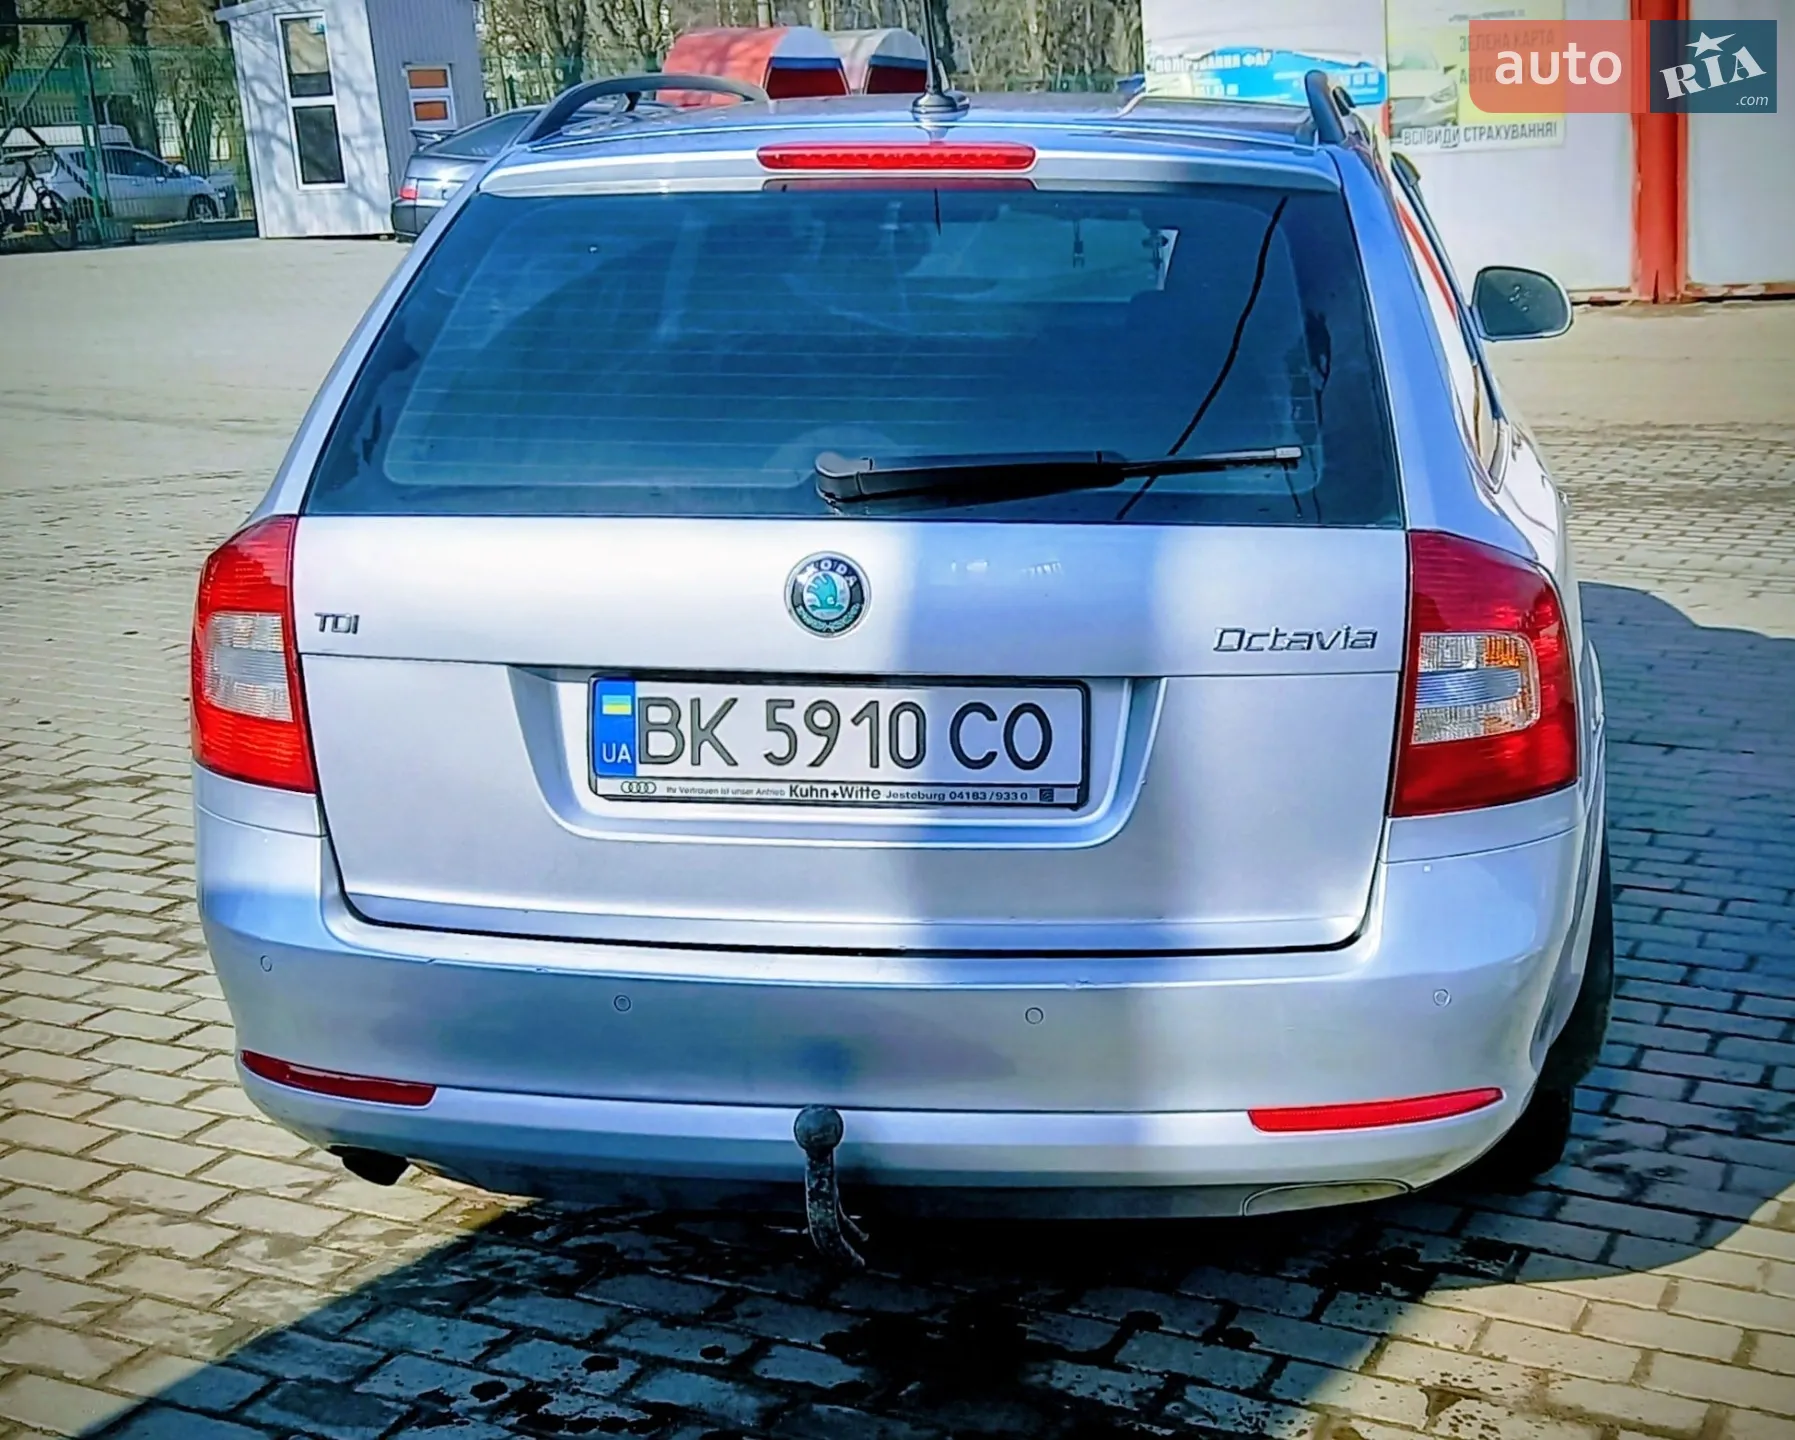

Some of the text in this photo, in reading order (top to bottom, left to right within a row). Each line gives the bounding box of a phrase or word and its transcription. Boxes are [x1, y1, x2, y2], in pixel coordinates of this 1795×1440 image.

[1403, 129, 1424, 146] ВСІ
[314, 612, 360, 635] TDI
[1213, 624, 1378, 652] Octavia
[637, 696, 1053, 771] BK 5910 CO
[602, 742, 632, 764] UA
